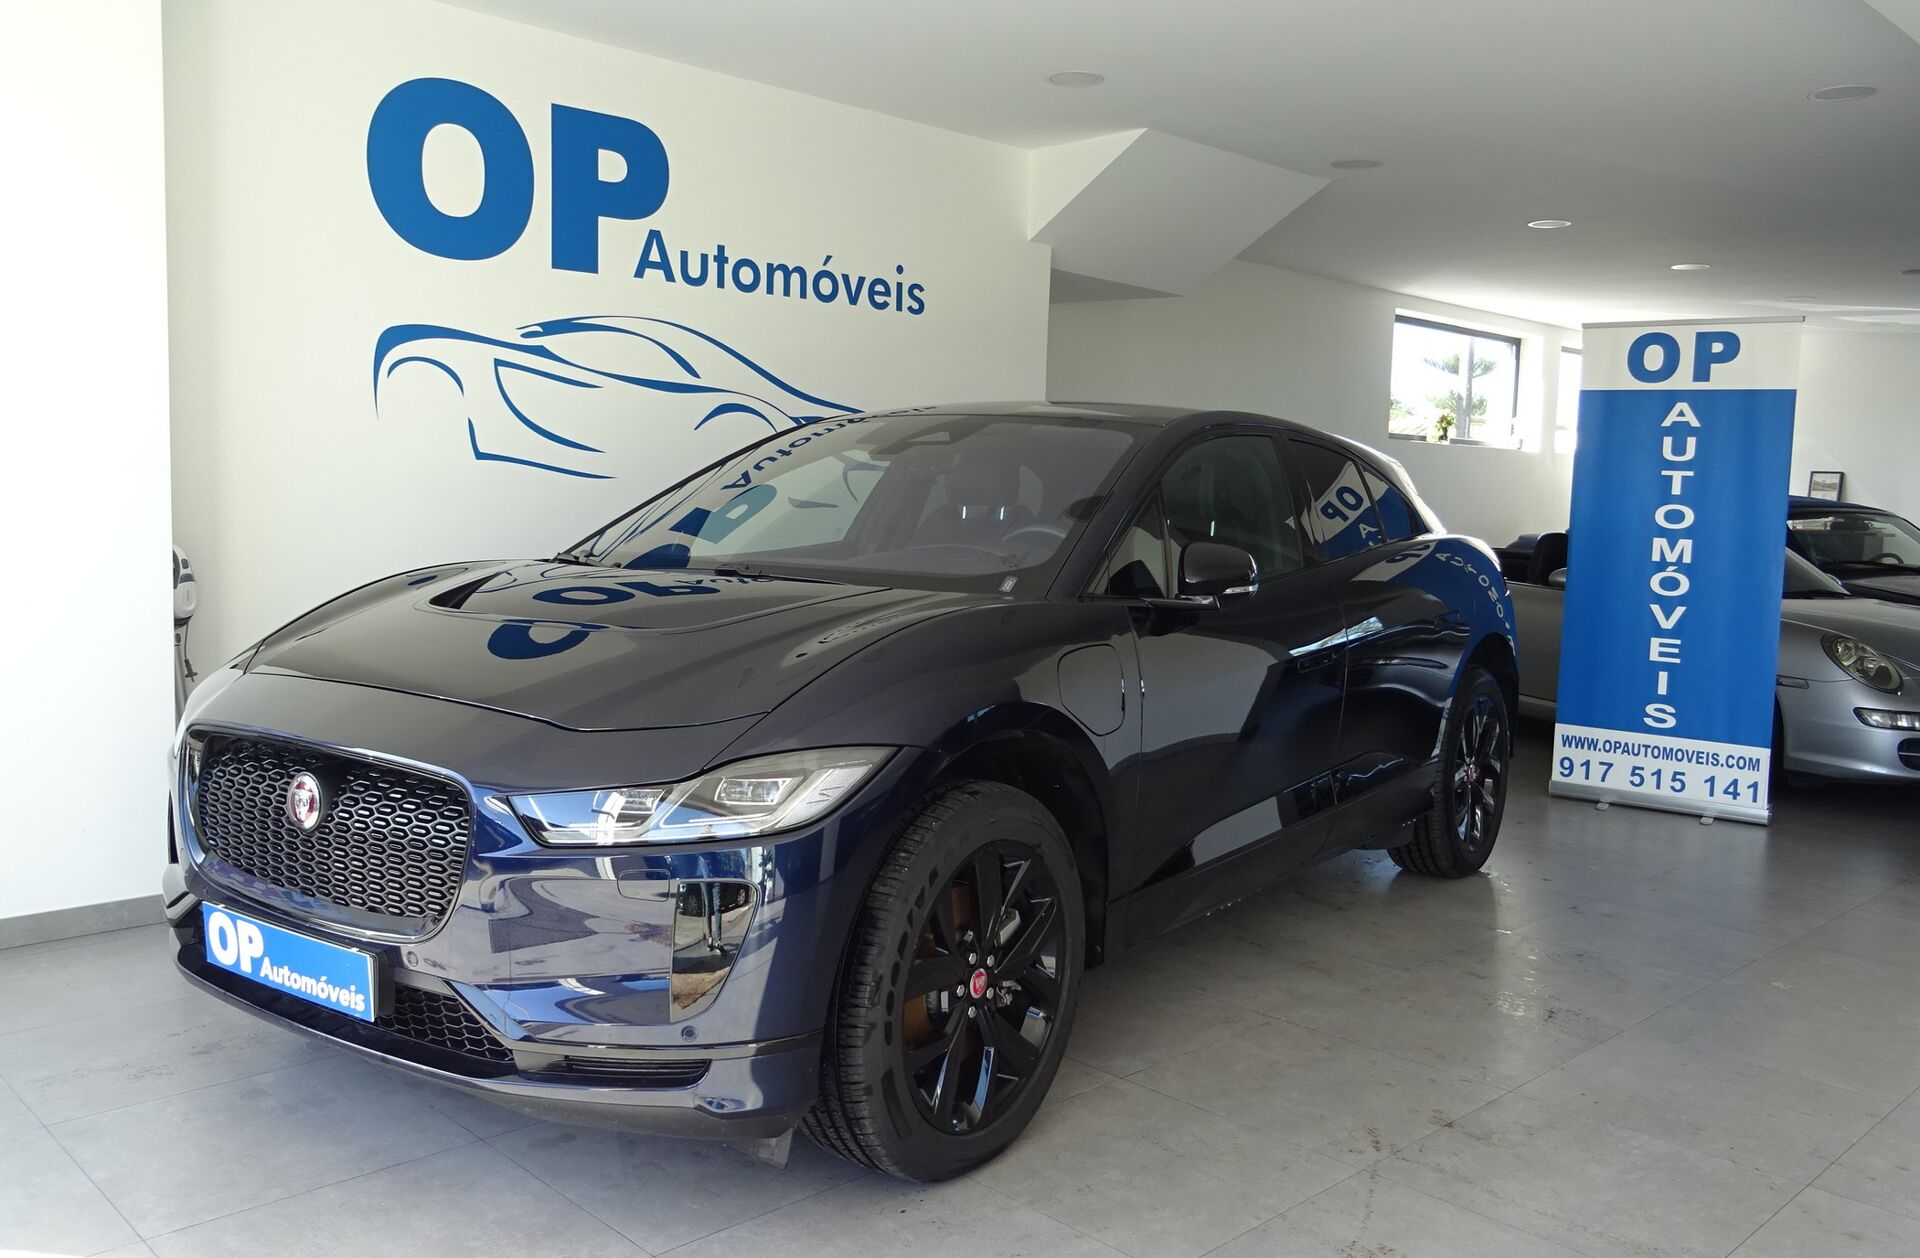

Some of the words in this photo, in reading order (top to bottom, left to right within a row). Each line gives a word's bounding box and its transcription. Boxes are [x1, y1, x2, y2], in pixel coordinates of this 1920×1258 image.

[367, 77, 670, 274] OP
[633, 229, 926, 316] Automóveis
[1627, 331, 1741, 383] OP
[1643, 402, 1701, 730] AUTOMÓVEIS
[1559, 756, 1614, 783] 917
[1629, 765, 1686, 793] 515
[1704, 775, 1759, 803] 141
[1561, 734, 1761, 772] WWW.OPAUTOMOVEIS.COM
[208, 911, 264, 973] OP
[259, 956, 365, 1011] Automóveis
